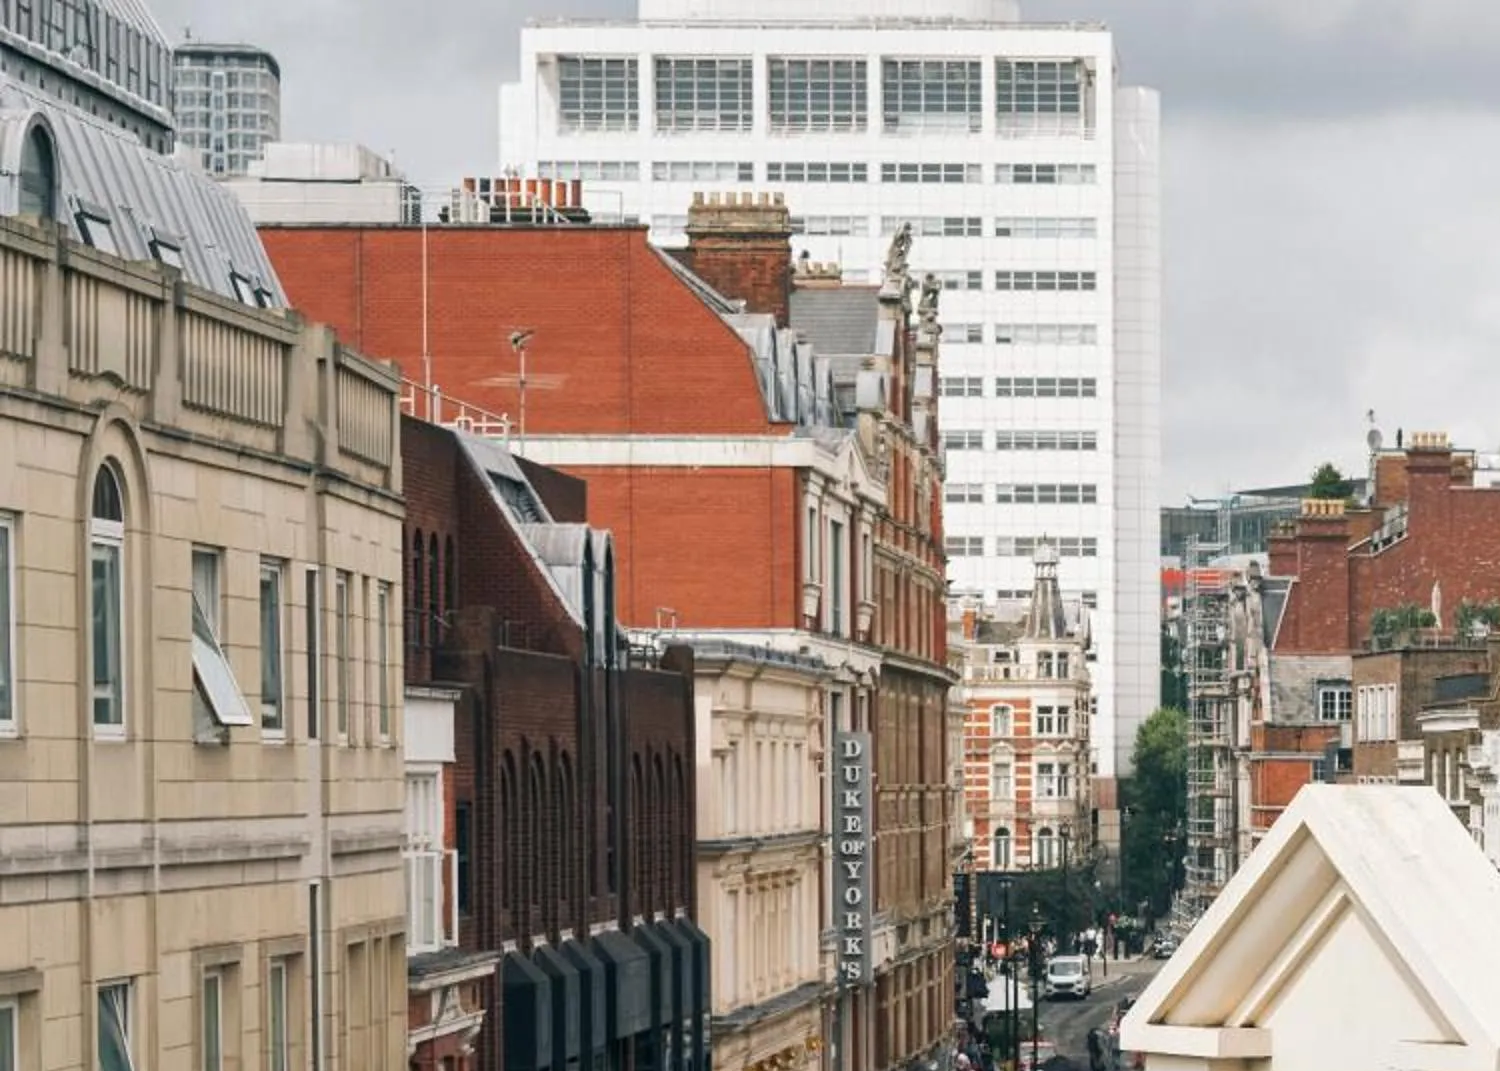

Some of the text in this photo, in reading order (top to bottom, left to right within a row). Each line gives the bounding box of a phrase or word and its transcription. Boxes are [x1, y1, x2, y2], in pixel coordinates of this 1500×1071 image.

[841, 739, 865, 980] DUKE OF YORK'S
